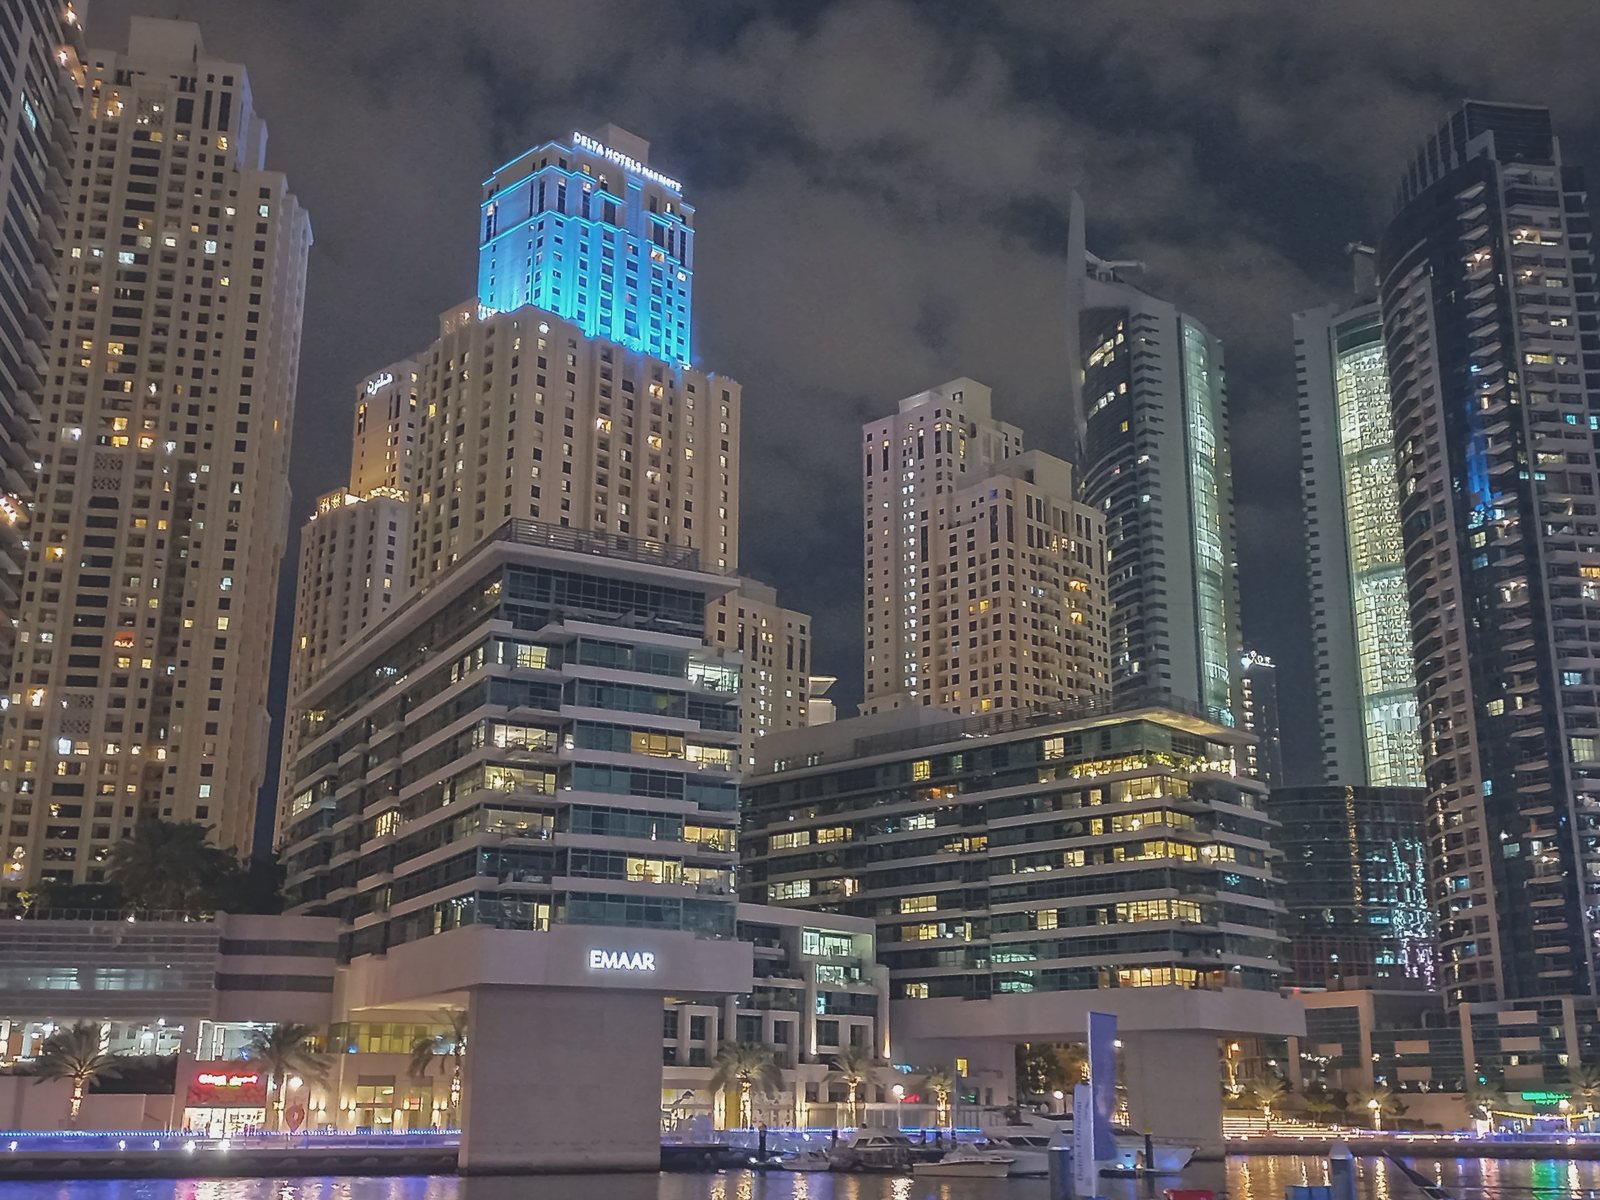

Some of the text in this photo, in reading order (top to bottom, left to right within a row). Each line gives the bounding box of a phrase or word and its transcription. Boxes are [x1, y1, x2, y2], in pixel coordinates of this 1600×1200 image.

[573, 131, 605, 156] DELTA
[604, 147, 642, 174] HOTELS
[590, 949, 656, 971] EMAAR
